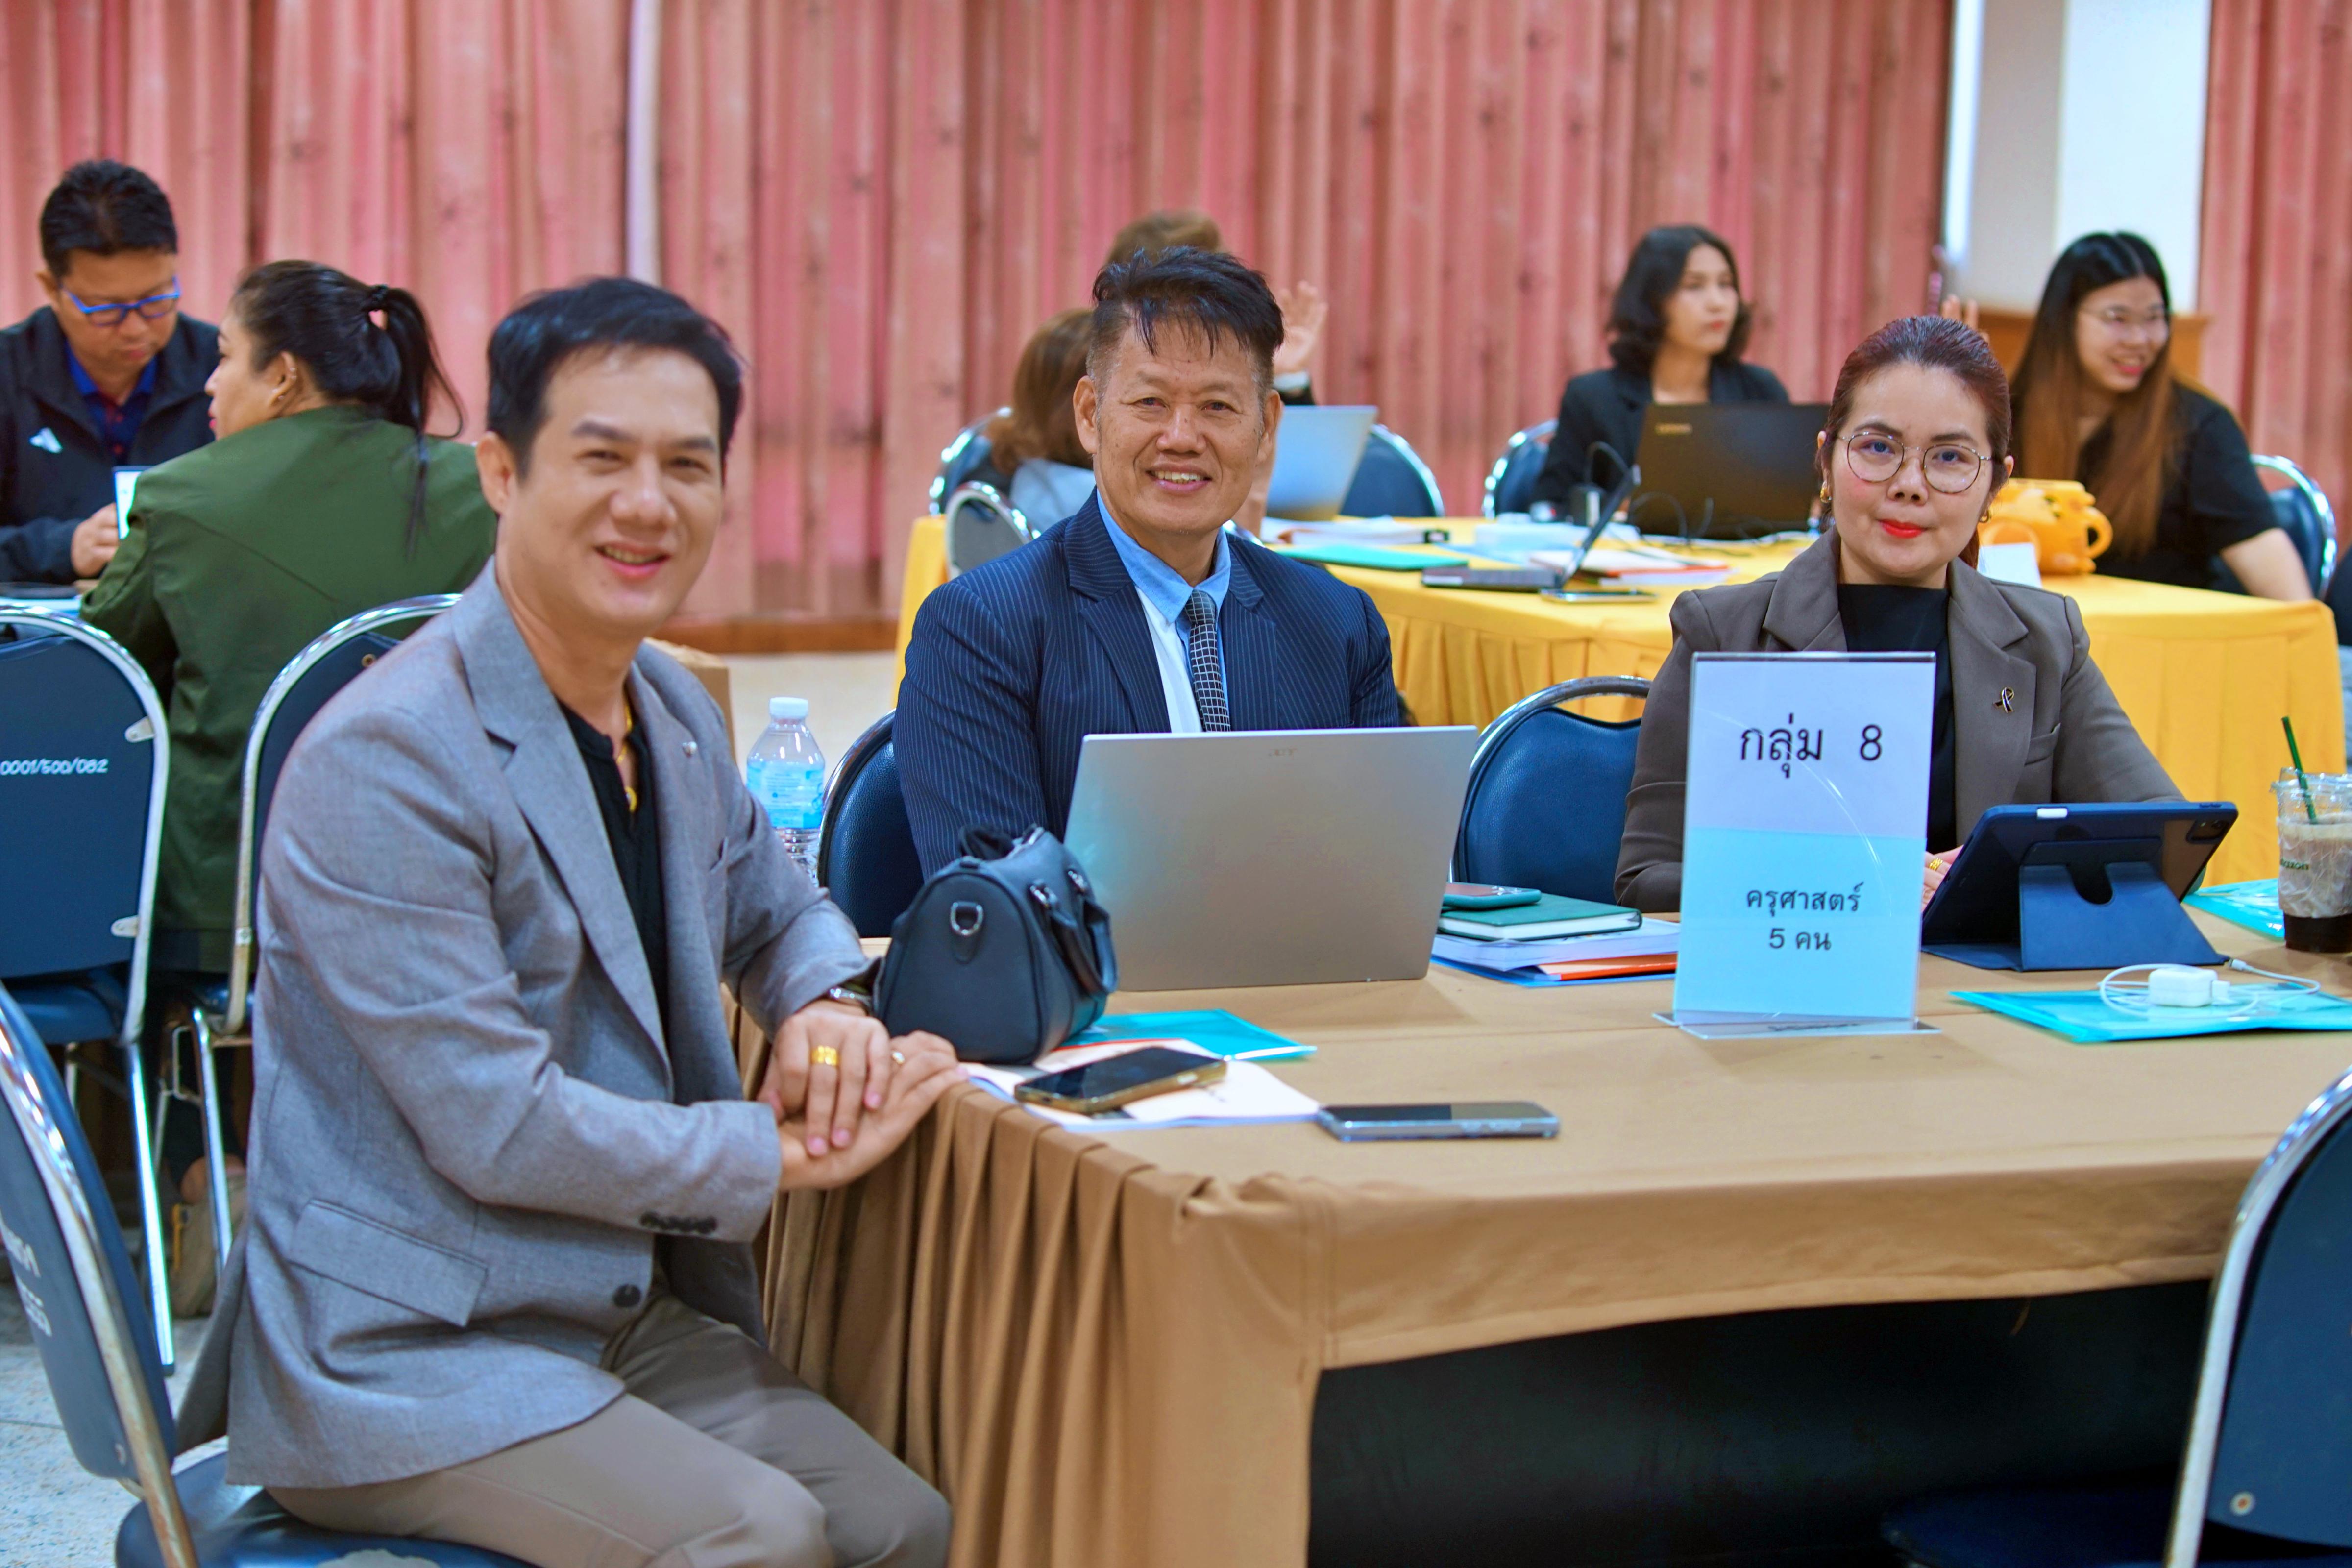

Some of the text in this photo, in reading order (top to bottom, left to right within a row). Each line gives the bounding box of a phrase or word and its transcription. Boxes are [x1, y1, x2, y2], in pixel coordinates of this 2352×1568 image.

[1740, 712, 1883, 779] กลุ่ม 8
[1746, 881, 1865, 918] ครุศาสตร์
[1769, 927, 1832, 951] 5 คน
